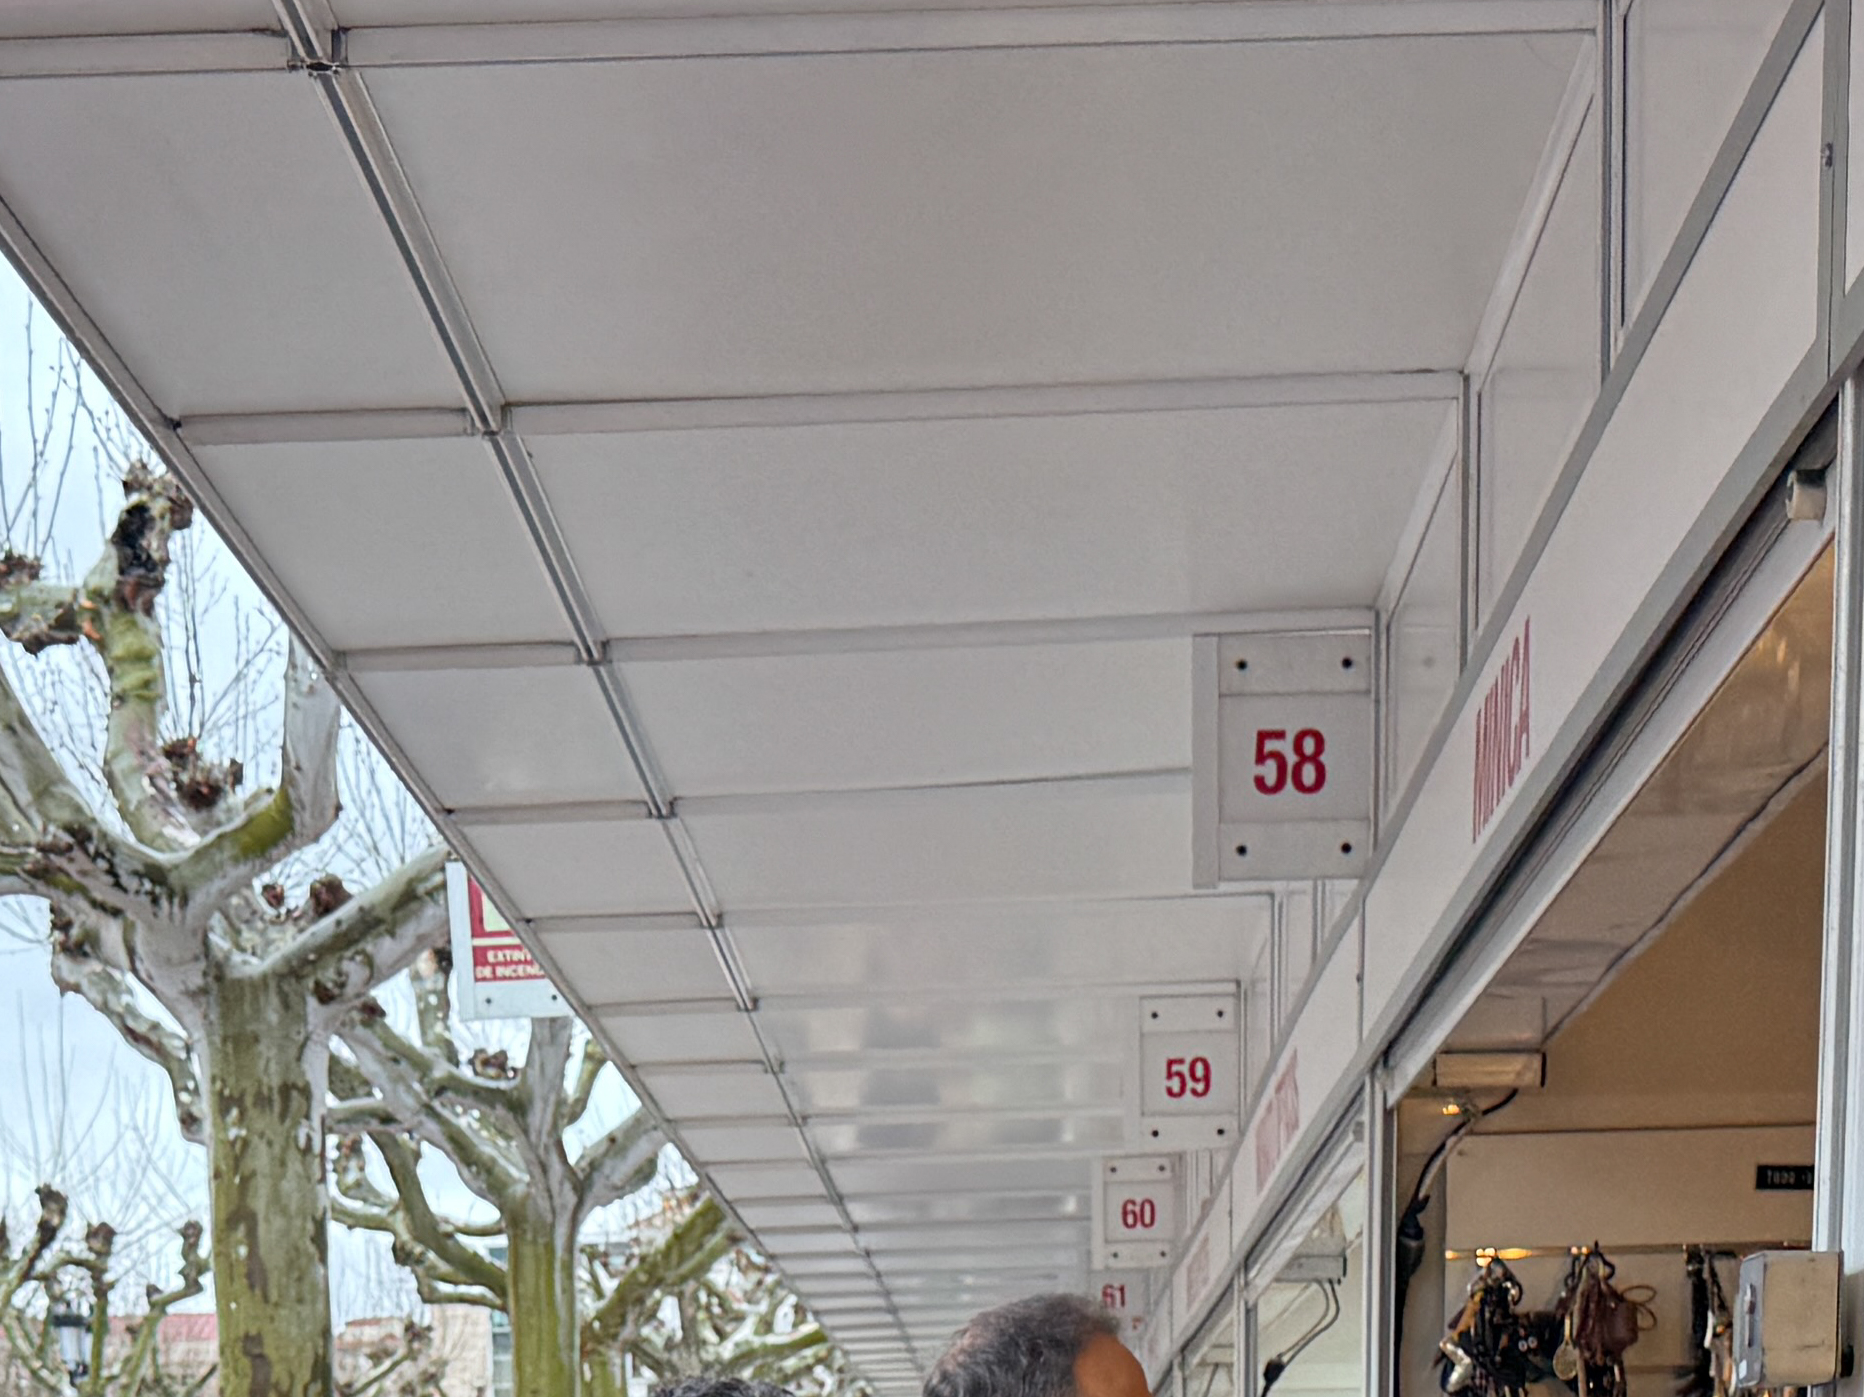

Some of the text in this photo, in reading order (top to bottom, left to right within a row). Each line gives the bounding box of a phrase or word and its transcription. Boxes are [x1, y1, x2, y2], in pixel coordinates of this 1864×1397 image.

[1253, 728, 1327, 796] 58
[1165, 1056, 1212, 1099] 59
[1120, 1198, 1156, 1229] 60
[1102, 1284, 1126, 1309] 61
